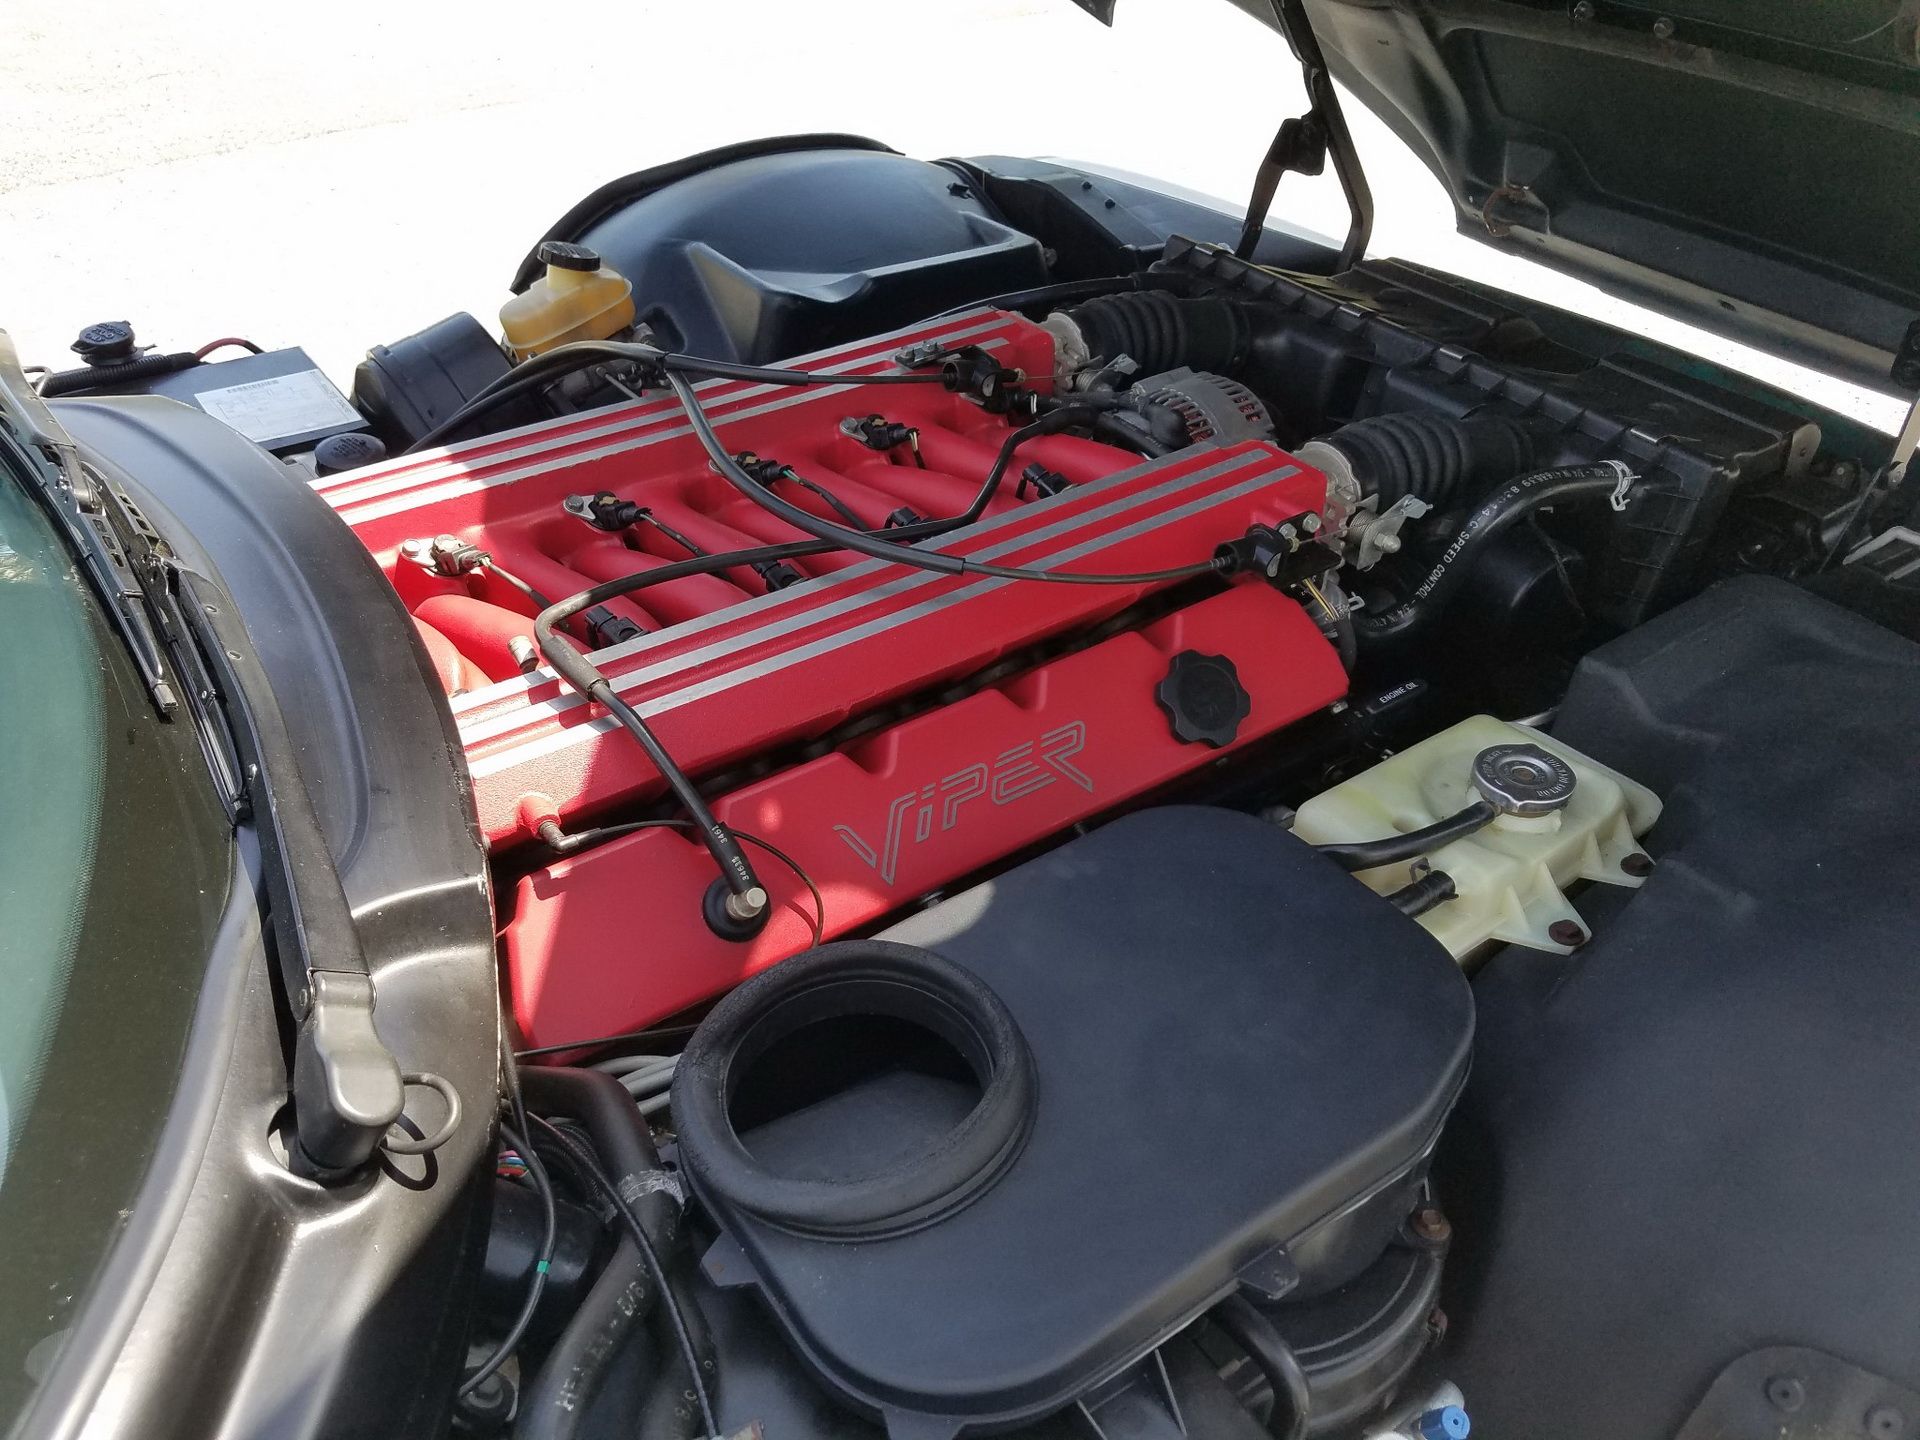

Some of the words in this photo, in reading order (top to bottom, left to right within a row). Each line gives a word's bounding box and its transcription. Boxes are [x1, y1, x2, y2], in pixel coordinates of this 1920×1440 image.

[1443, 531, 1470, 563] SPEED
[1415, 564, 1446, 599] CONTROL
[1379, 686, 1407, 704] ENGINE
[1405, 681, 1419, 690] OIL
[711, 824, 728, 844] 3461
